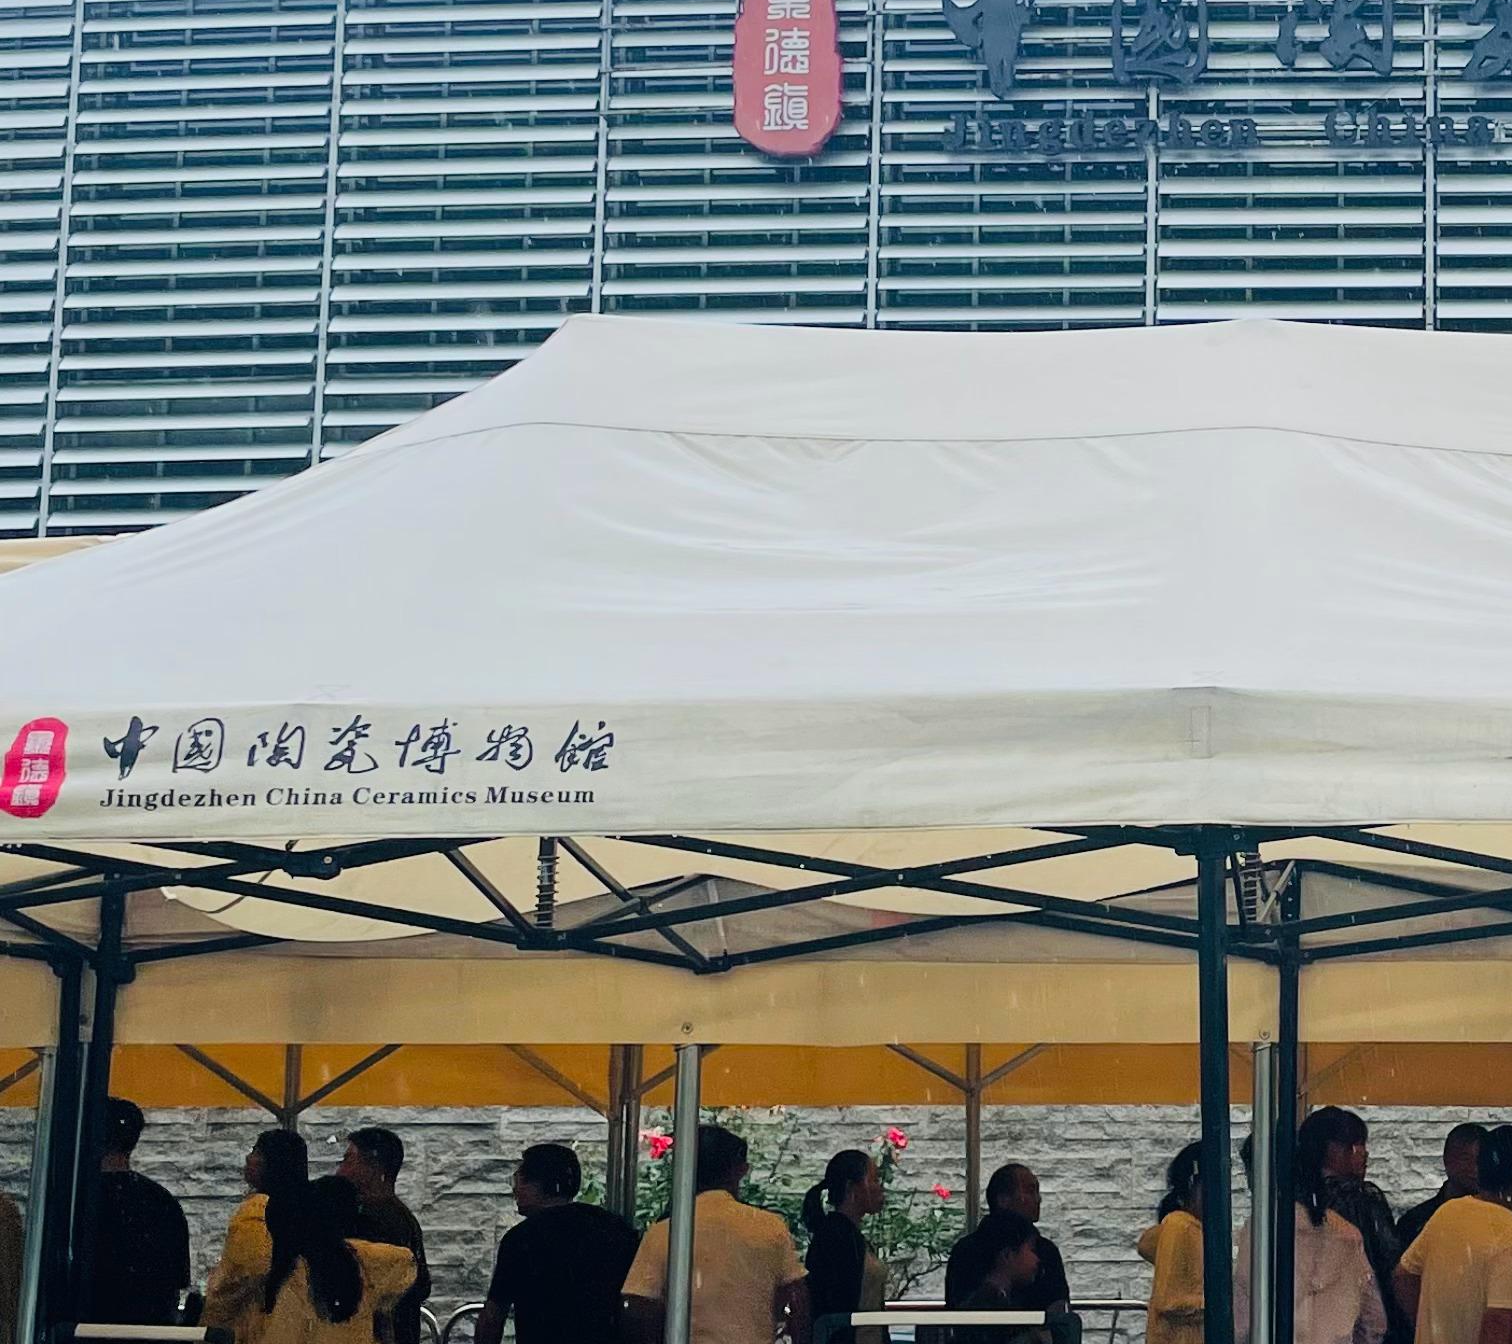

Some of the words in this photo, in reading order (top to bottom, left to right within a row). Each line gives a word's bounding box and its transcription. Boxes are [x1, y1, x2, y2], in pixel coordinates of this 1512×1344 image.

[944, 109, 1259, 155] Jingdezhen
[1325, 108, 1496, 147] China
[100, 787, 257, 811] Jingdezhen
[265, 787, 344, 807] China
[351, 787, 477, 806] Ceramics
[484, 787, 596, 805] Museum
